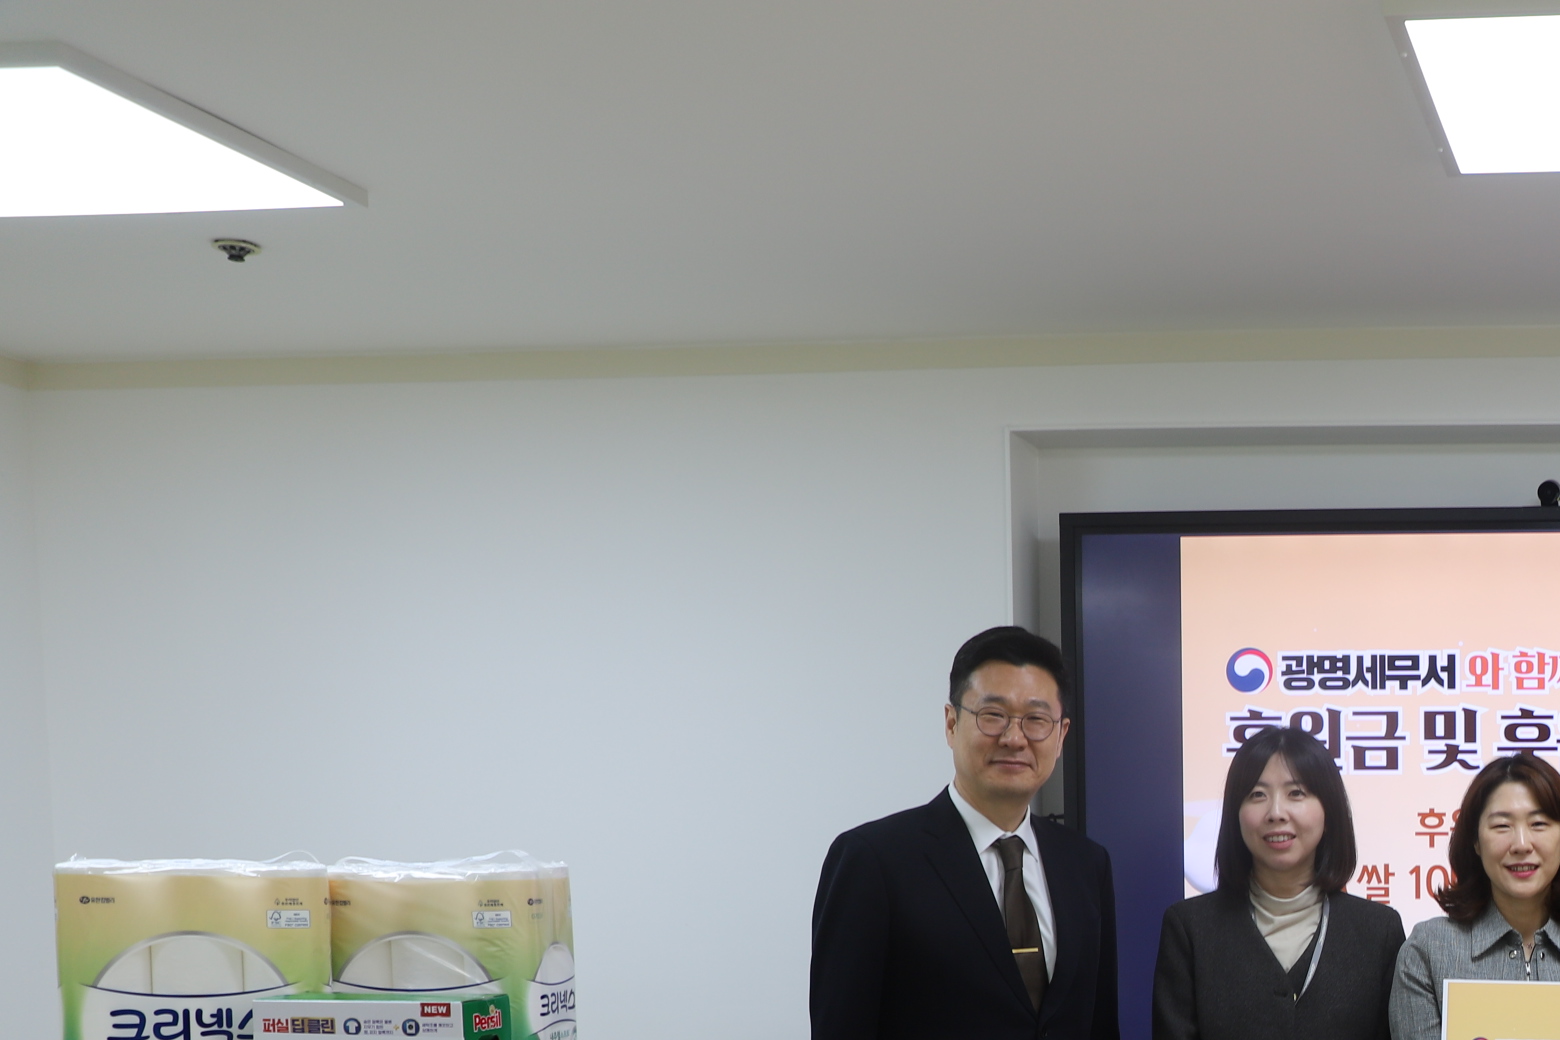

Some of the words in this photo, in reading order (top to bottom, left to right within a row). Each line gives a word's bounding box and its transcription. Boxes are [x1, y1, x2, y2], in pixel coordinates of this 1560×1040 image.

[1280, 652, 1457, 691] 광명세무서
[1466, 652, 1500, 690] 와
[1424, 706, 1480, 771] 및
[424, 1005, 447, 1014] NEW
[540, 989, 575, 1017] 크리넥스
[473, 1010, 502, 1032] Persil
